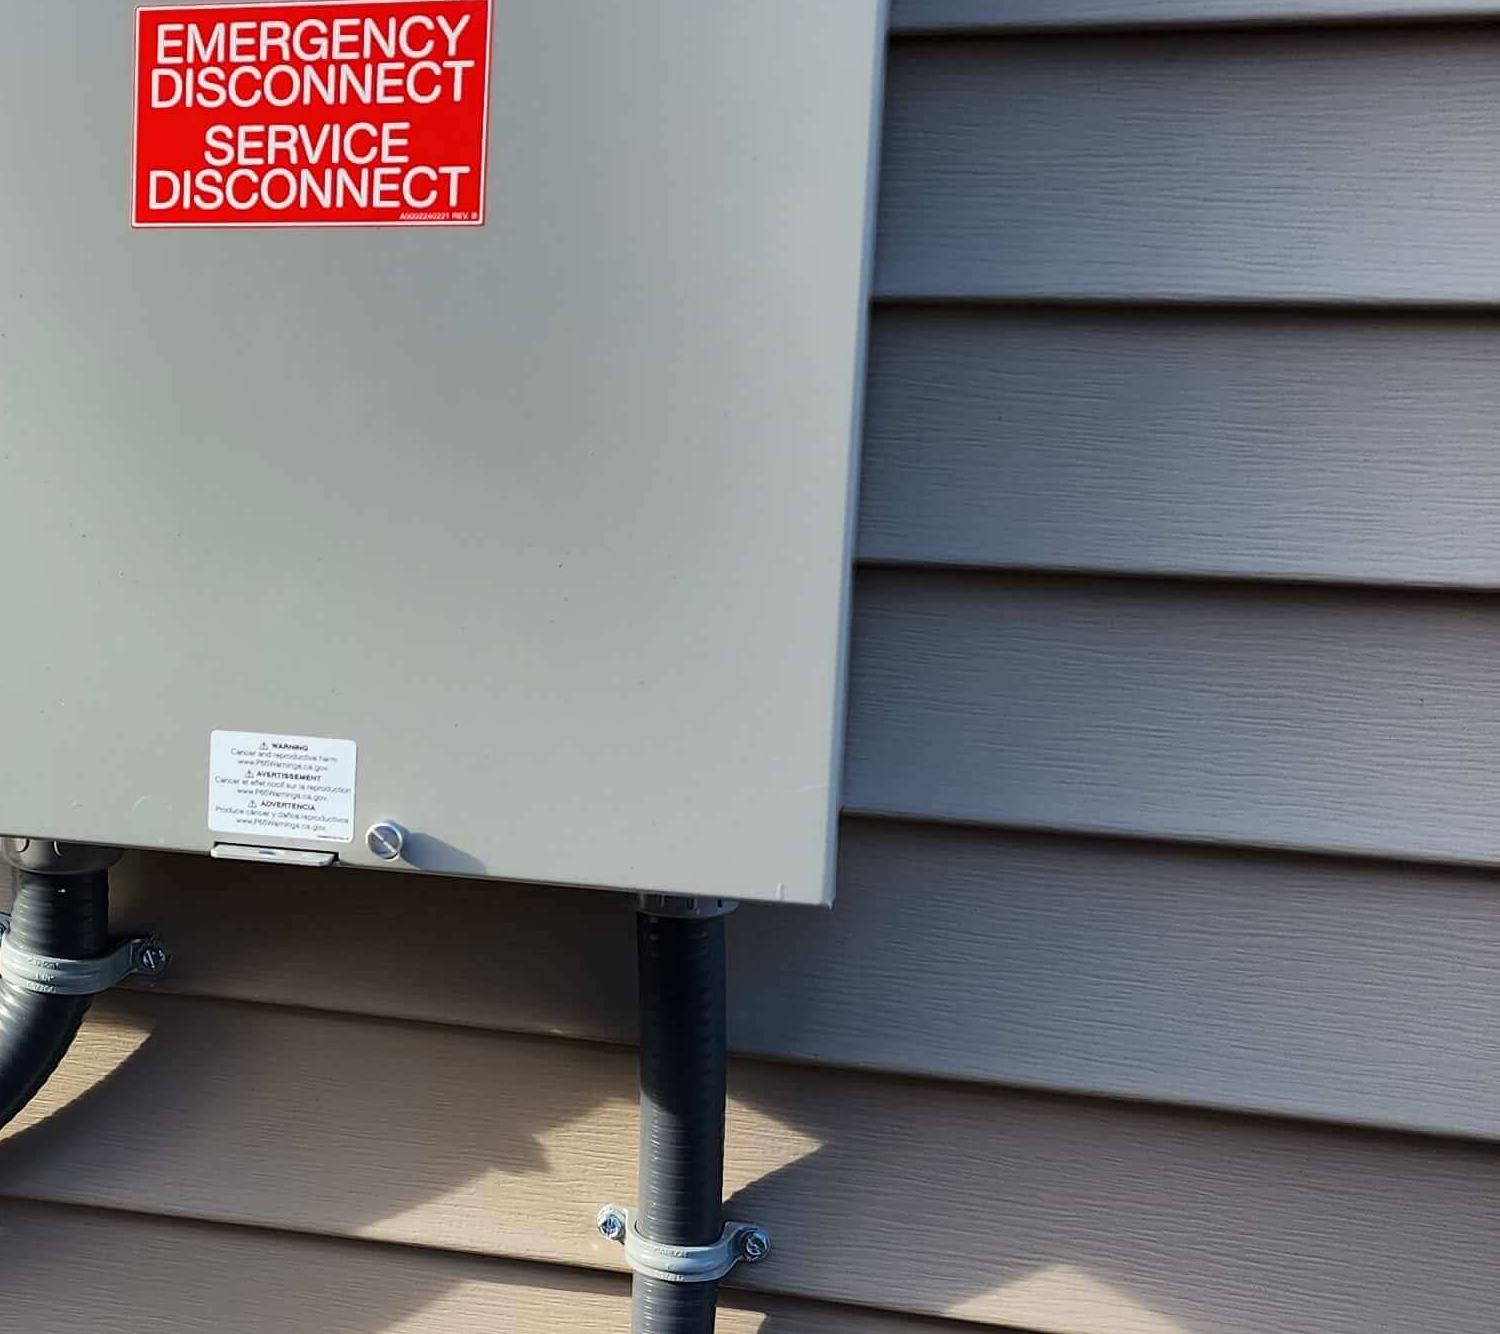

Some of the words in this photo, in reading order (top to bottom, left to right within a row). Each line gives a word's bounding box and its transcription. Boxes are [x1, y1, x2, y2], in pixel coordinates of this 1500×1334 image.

[156, 14, 471, 64] EMERGENCY
[151, 60, 475, 108] DISCONNECT
[203, 122, 410, 167] SERVICE
[149, 166, 471, 210] DISCONNECT
[271, 742, 309, 751] WARNING
[230, 747, 256, 756] Cancer
[273, 751, 317, 762] reproductive
[214, 775, 240, 784] Cancer
[256, 770, 322, 782] AVERTISSEMENT
[260, 800, 316, 811] ADVERTENCIA
